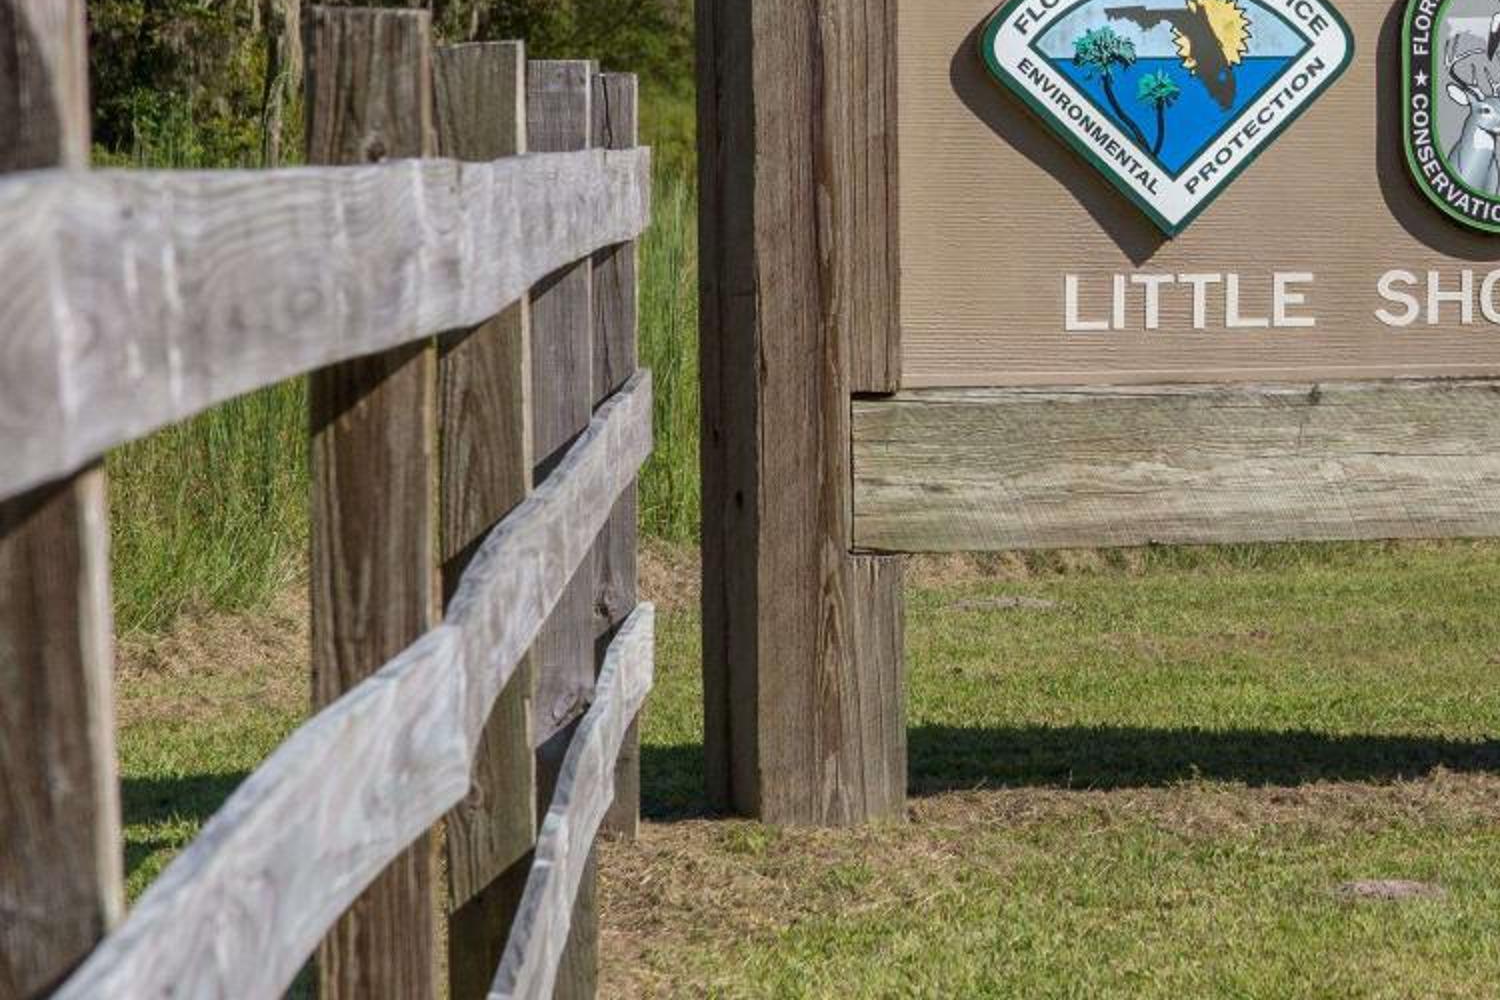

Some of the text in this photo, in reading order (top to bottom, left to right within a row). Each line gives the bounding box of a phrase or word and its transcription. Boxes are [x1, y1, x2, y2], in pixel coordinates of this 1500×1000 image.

[1016, 57, 1158, 196] ENVIRONMENTAL
[1184, 56, 1327, 194] PROTECTION
[1065, 271, 1316, 331] LITTLE
